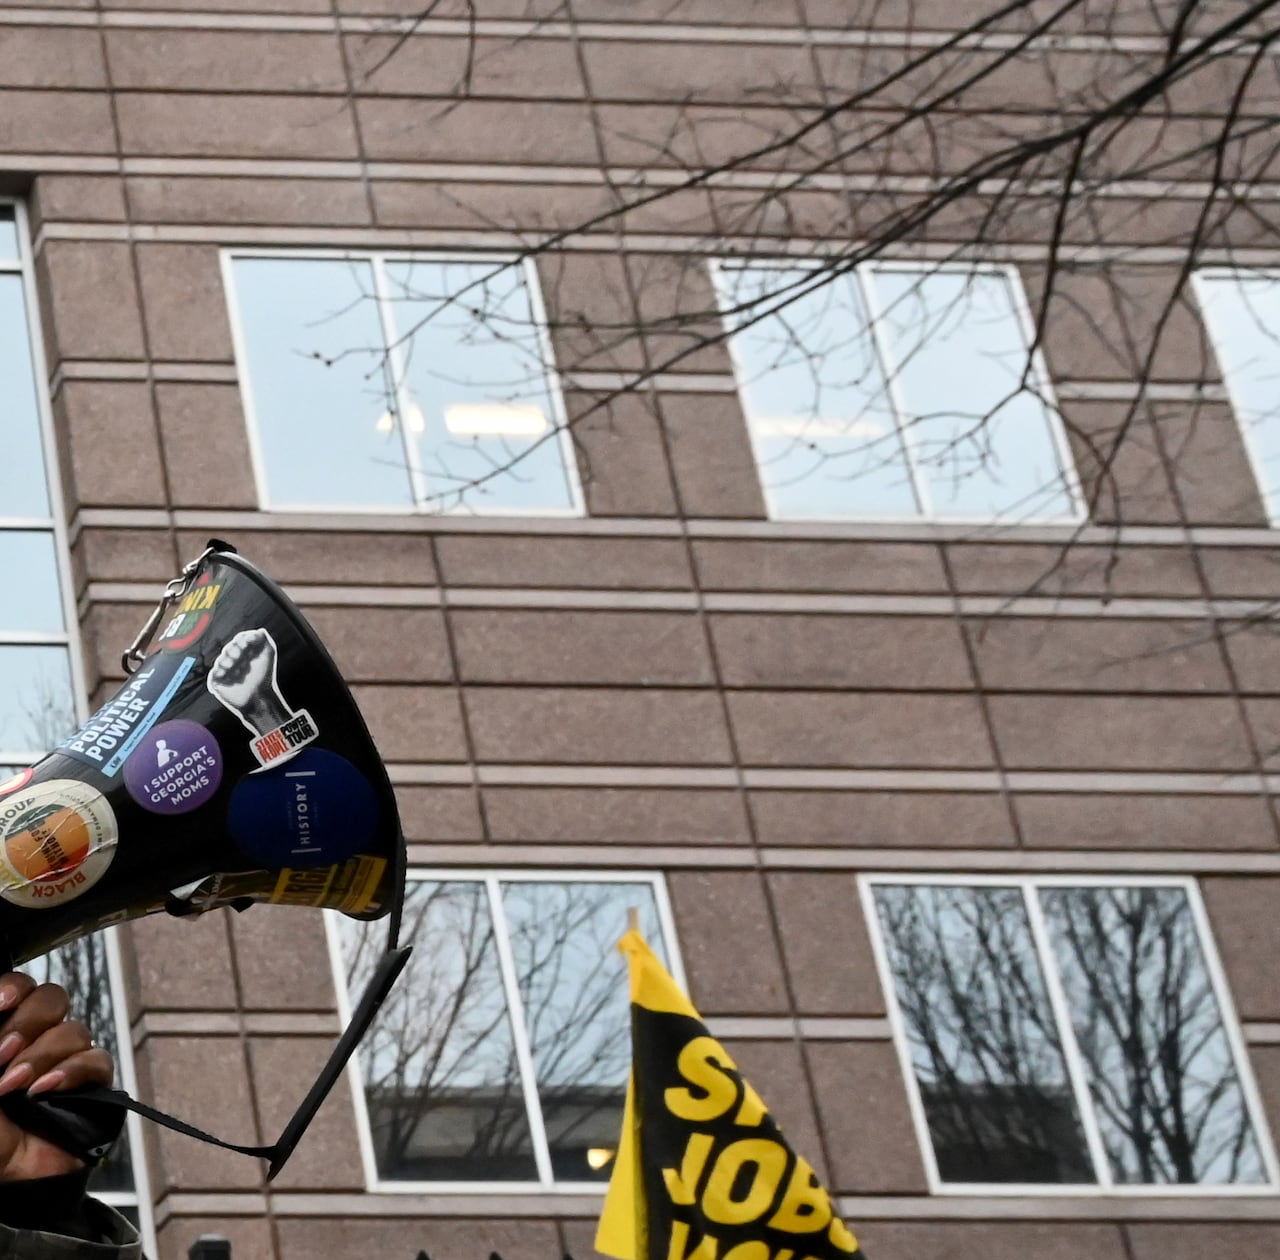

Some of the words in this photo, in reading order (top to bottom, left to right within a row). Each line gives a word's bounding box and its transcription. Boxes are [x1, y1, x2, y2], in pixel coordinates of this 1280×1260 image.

[69, 668, 156, 752] POLITICAL
[279, 714, 309, 737] POWER
[86, 698, 151, 762] POWER
[286, 724, 315, 748] TOUR
[143, 784, 150, 793] I
[151, 745, 208, 788] SUPPORT
[259, 739, 289, 763] PEOPLE
[150, 756, 216, 803] GEORGIA'S
[171, 775, 210, 806] MOMS
[295, 783, 311, 845] HISTORY
[31, 872, 87, 897] BLACK
